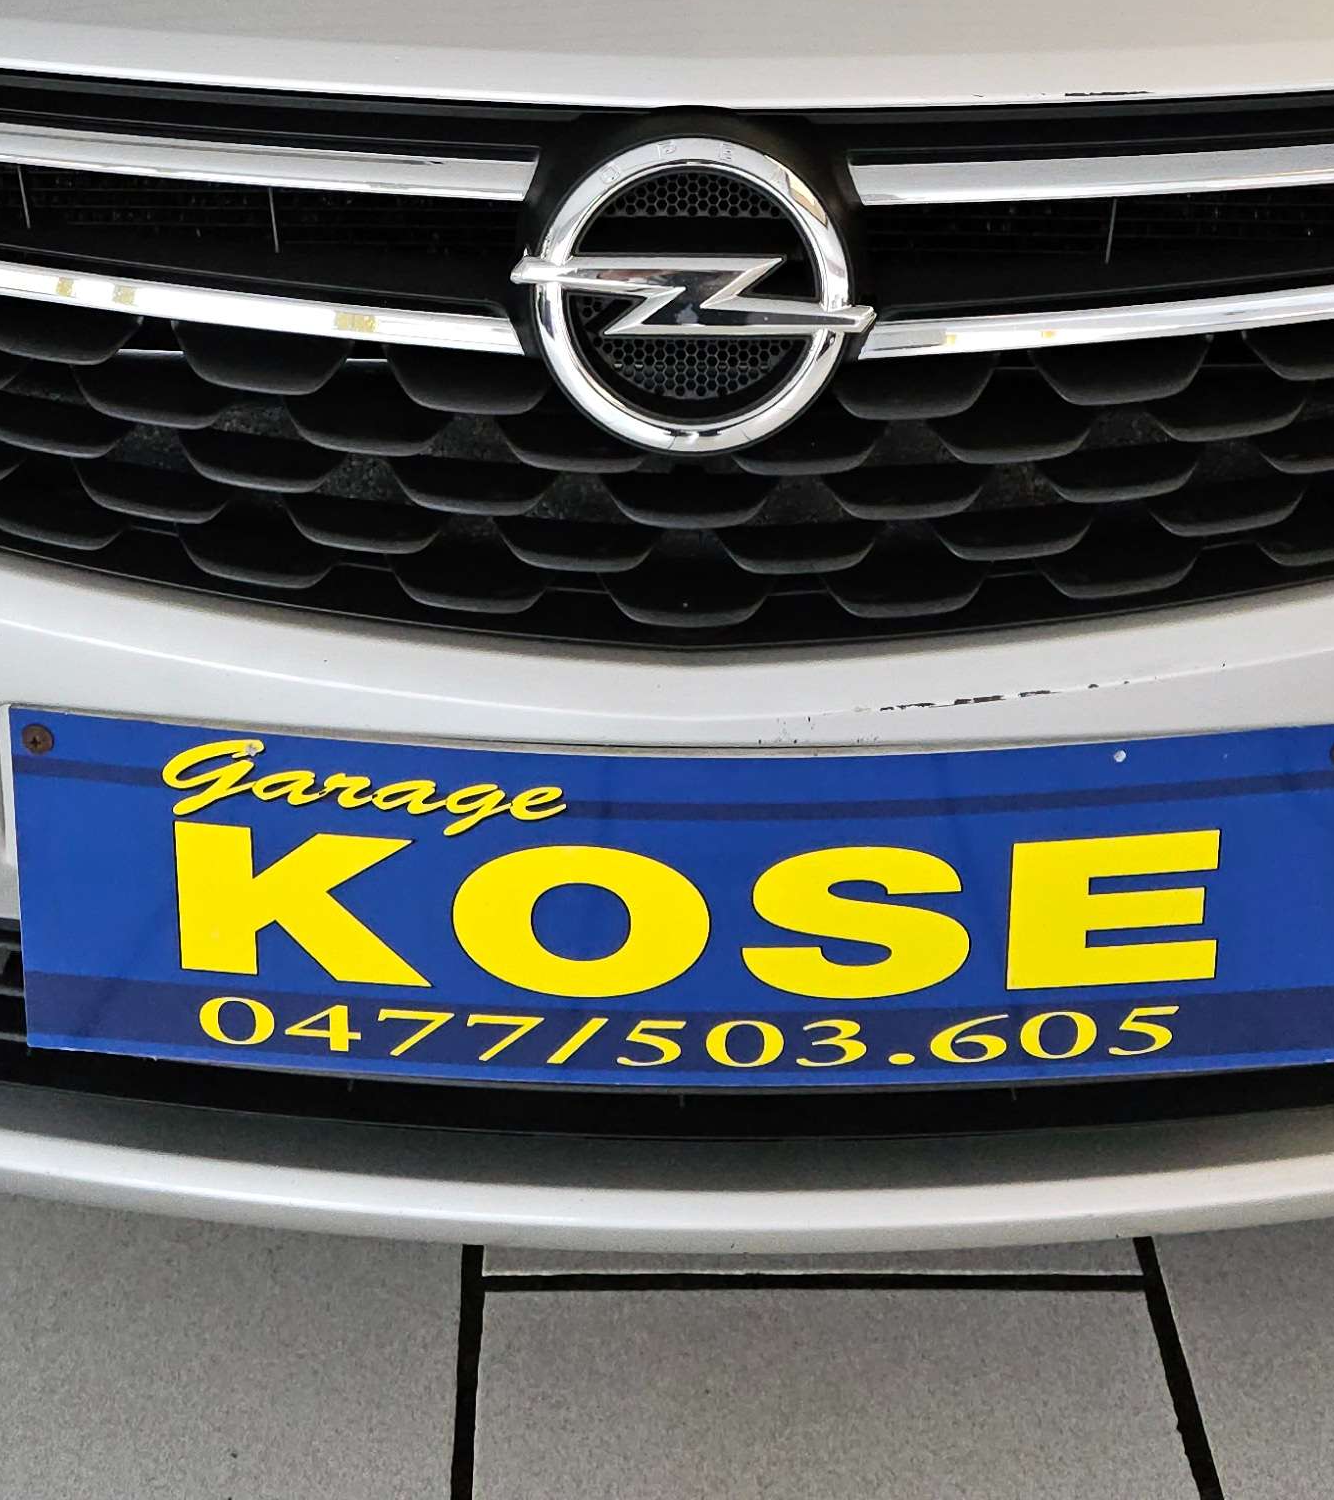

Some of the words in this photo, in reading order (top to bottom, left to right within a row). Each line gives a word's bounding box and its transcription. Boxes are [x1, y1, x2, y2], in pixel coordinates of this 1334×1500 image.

[161, 739, 566, 837] Garage
[173, 820, 1222, 999] KOSE
[198, 996, 1179, 1067] 0477/503.605
